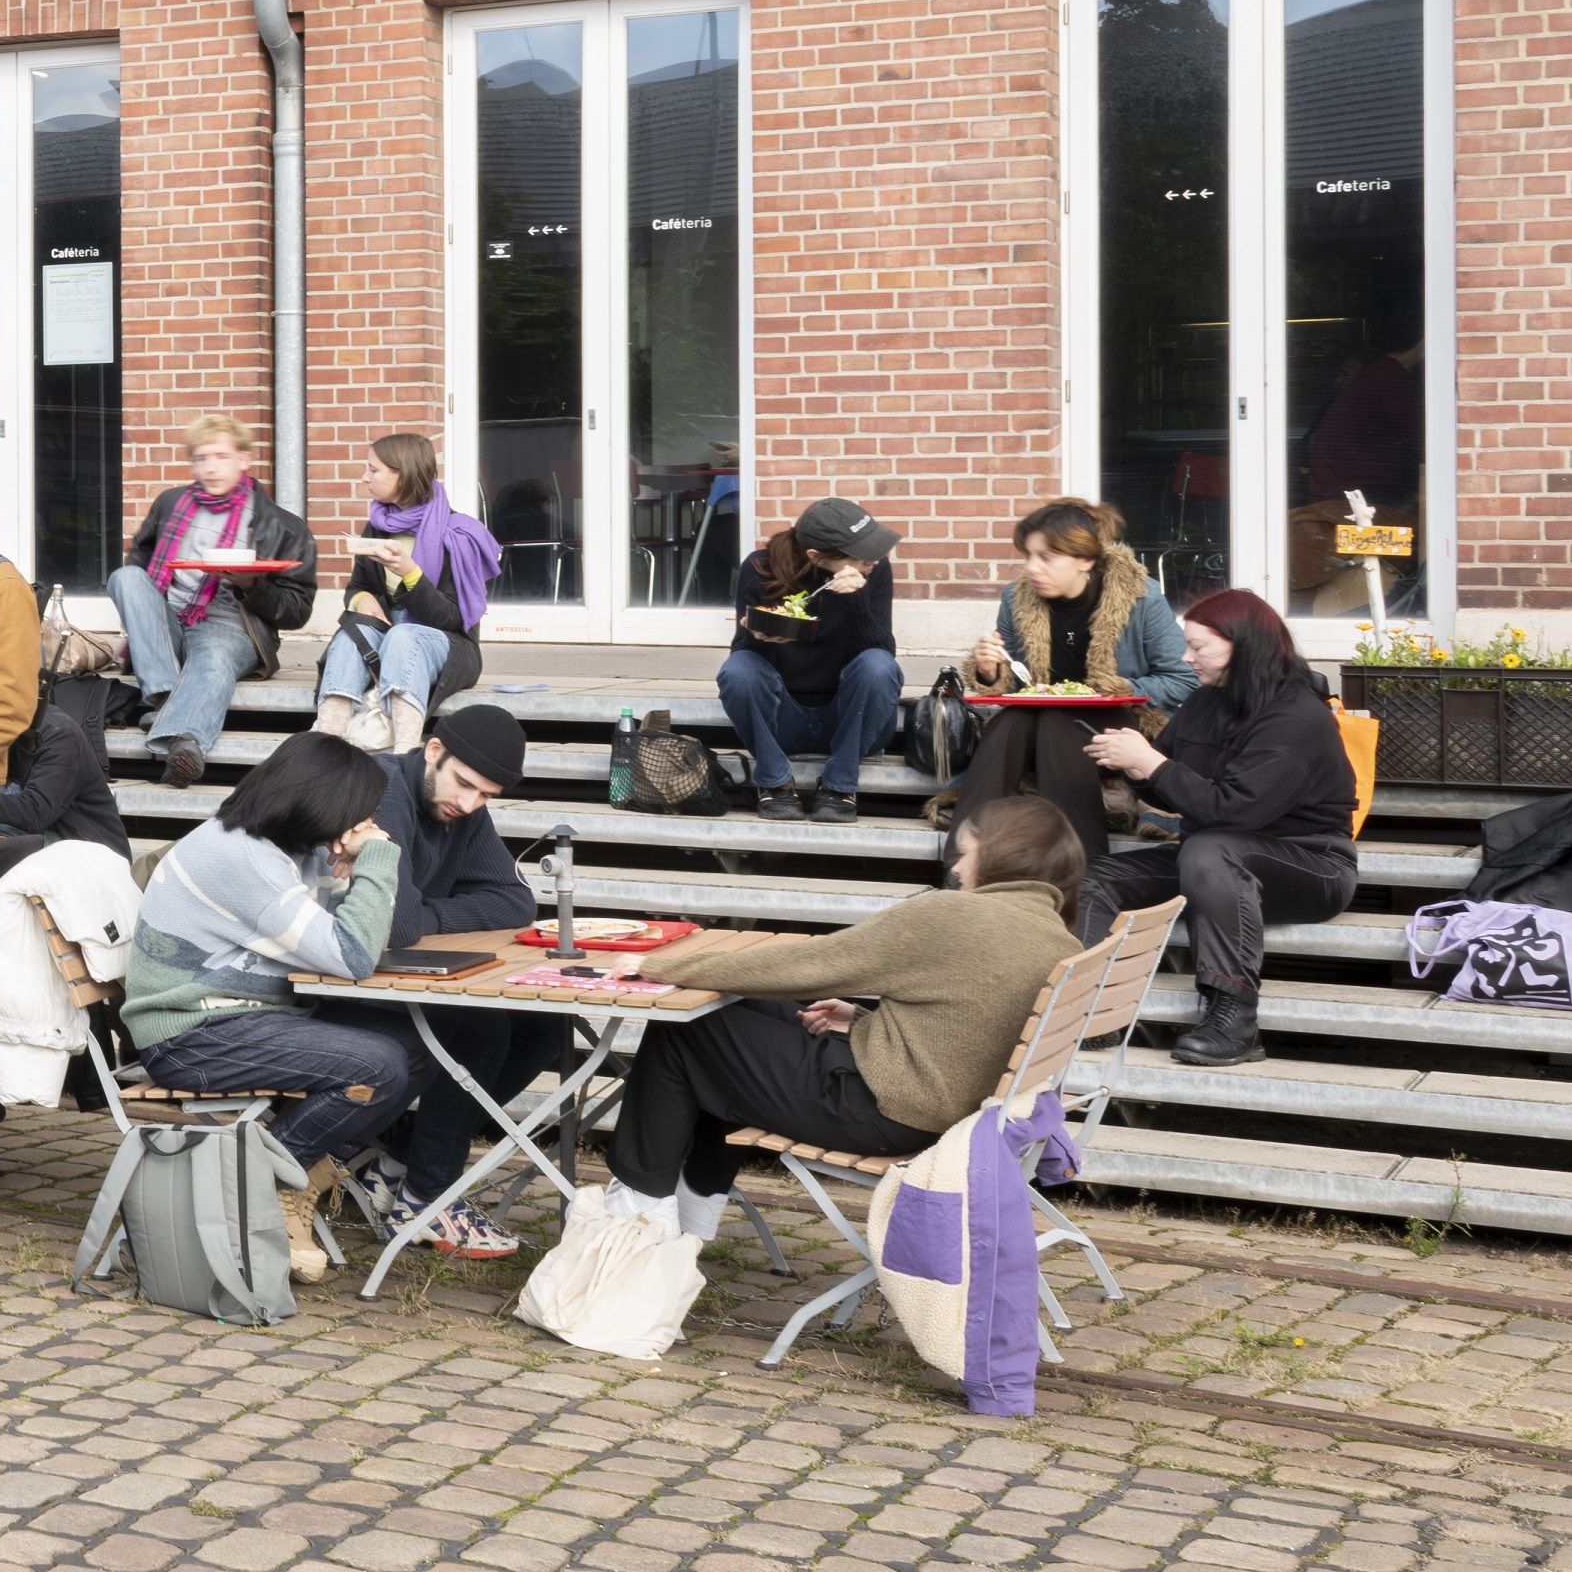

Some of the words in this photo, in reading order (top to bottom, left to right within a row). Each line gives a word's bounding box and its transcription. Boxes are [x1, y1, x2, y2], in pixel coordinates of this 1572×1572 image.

[1316, 178, 1391, 194] Cafeteria
[652, 216, 712, 231] Caféteria
[51, 246, 100, 259] Caféteria
